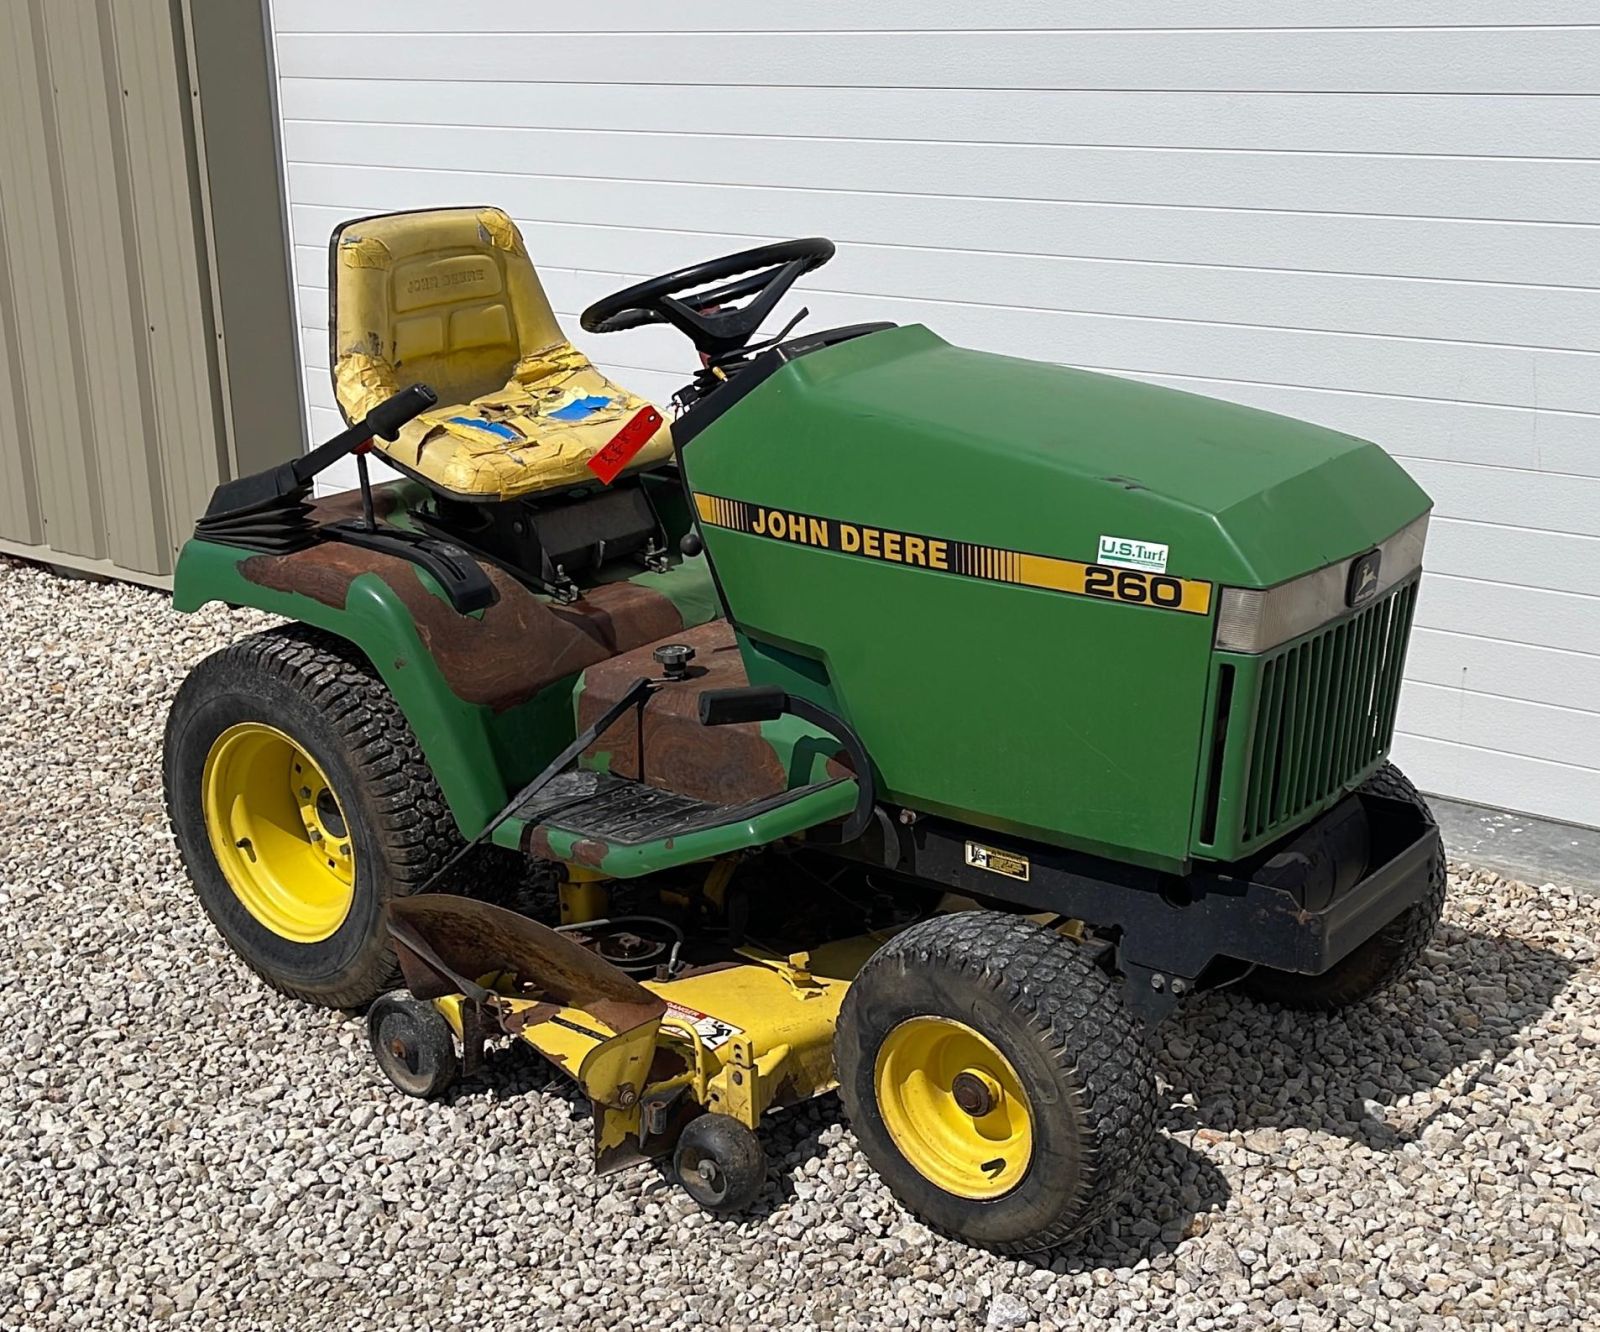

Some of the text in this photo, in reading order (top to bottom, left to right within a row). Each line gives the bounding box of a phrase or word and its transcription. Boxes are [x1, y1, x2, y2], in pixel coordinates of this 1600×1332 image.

[752, 508, 949, 570] JOHN DEERE
[1084, 565, 1183, 608] 260
